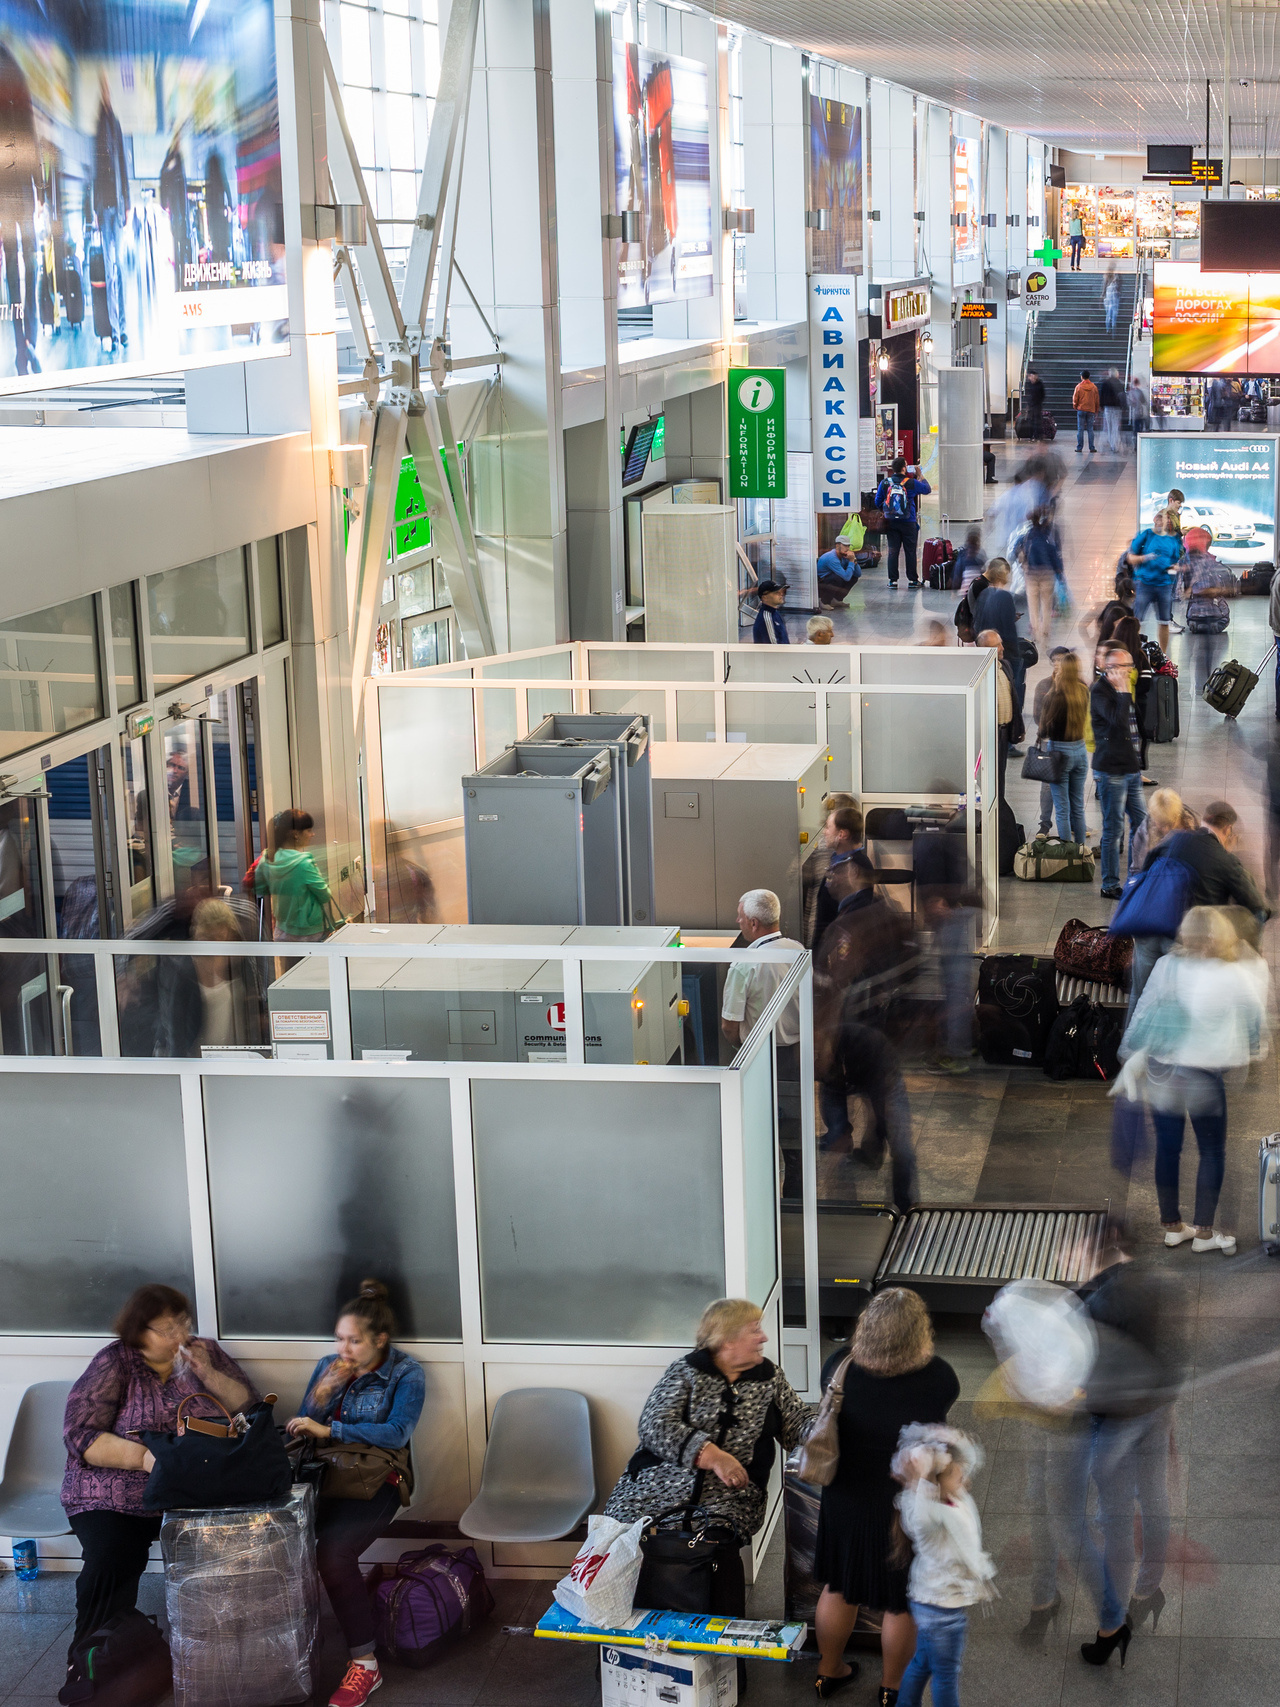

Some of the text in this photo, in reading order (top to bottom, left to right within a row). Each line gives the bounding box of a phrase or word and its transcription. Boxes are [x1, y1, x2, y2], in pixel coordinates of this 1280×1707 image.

[184, 262, 235, 286] ДВИЖЕНИЕ
[241, 260, 272, 280] ЖИЗНЬ
[822, 288, 850, 296] ИРКУТСК
[14, 303, 25, 320] 78
[183, 303, 202, 316] AMS
[1175, 299, 1233, 311] ДОРОГАХ
[821, 306, 851, 507] АВИАКАССЫ
[739, 418, 748, 487] INFORMATION
[766, 418, 776, 488] ИНФОРМАЦИЯ
[1175, 461, 1270, 471] Новый Audi A4
[1175, 472, 1233, 480] Прочувствуйте
[607, 1648, 619, 1666] hp
